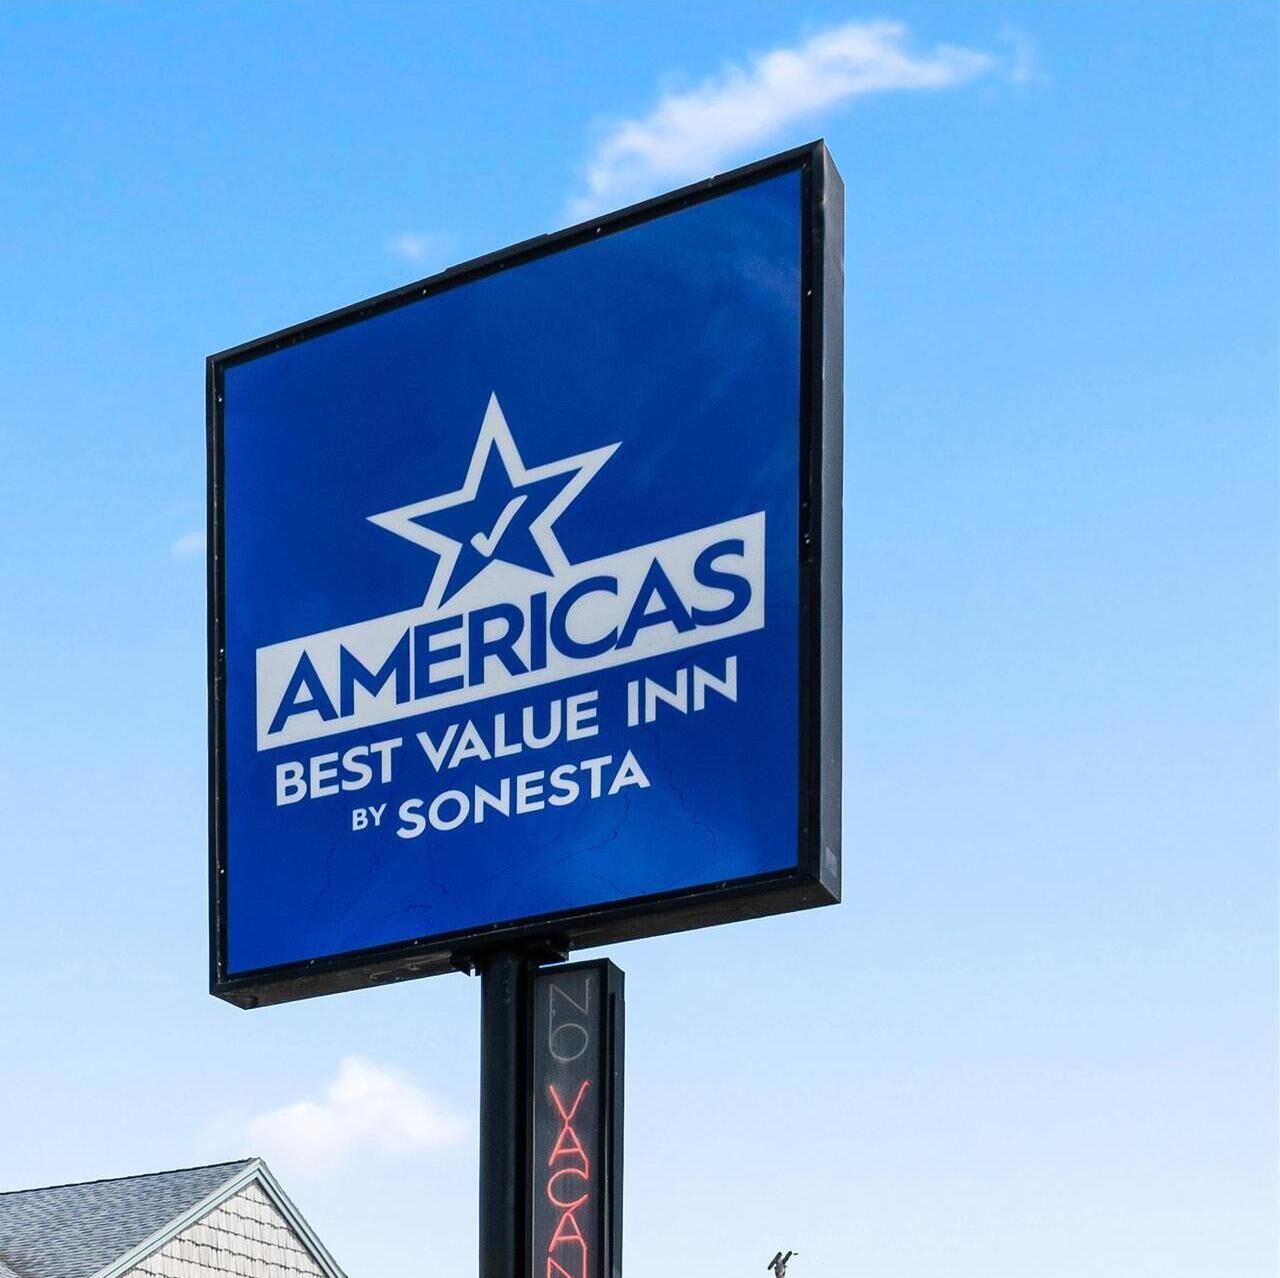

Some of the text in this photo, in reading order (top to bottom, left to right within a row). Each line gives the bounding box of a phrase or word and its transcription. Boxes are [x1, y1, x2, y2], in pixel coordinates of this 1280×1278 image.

[267, 539, 752, 735] AMERICAS
[276, 656, 738, 806] BEST VALUE INN
[352, 750, 651, 839] BY SONESTA
[548, 977, 591, 1063] NO
